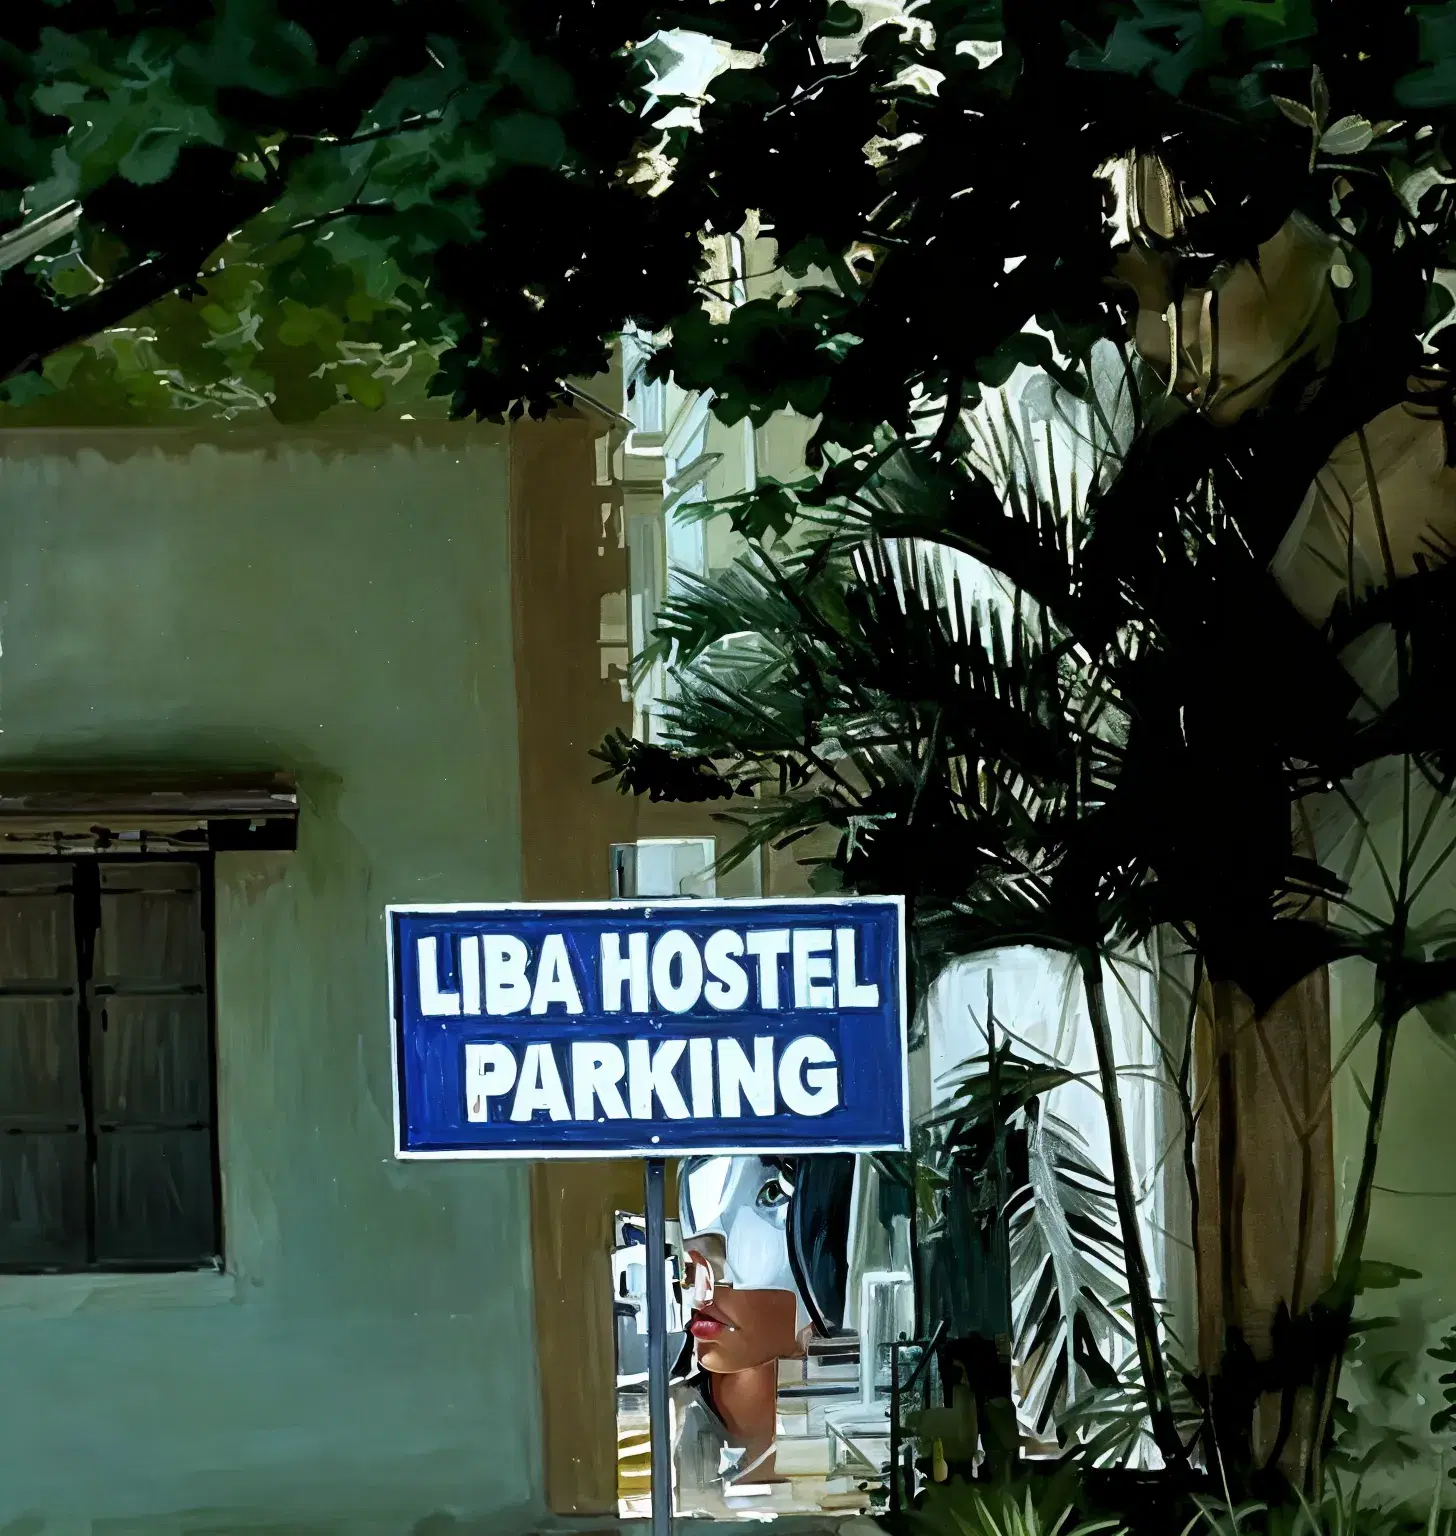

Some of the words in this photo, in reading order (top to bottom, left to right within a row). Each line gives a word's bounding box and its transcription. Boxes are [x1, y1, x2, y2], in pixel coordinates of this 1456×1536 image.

[416, 931, 585, 1017] LIBA
[600, 928, 880, 1015] HOSTEL
[464, 1034, 841, 1123] PARKING
